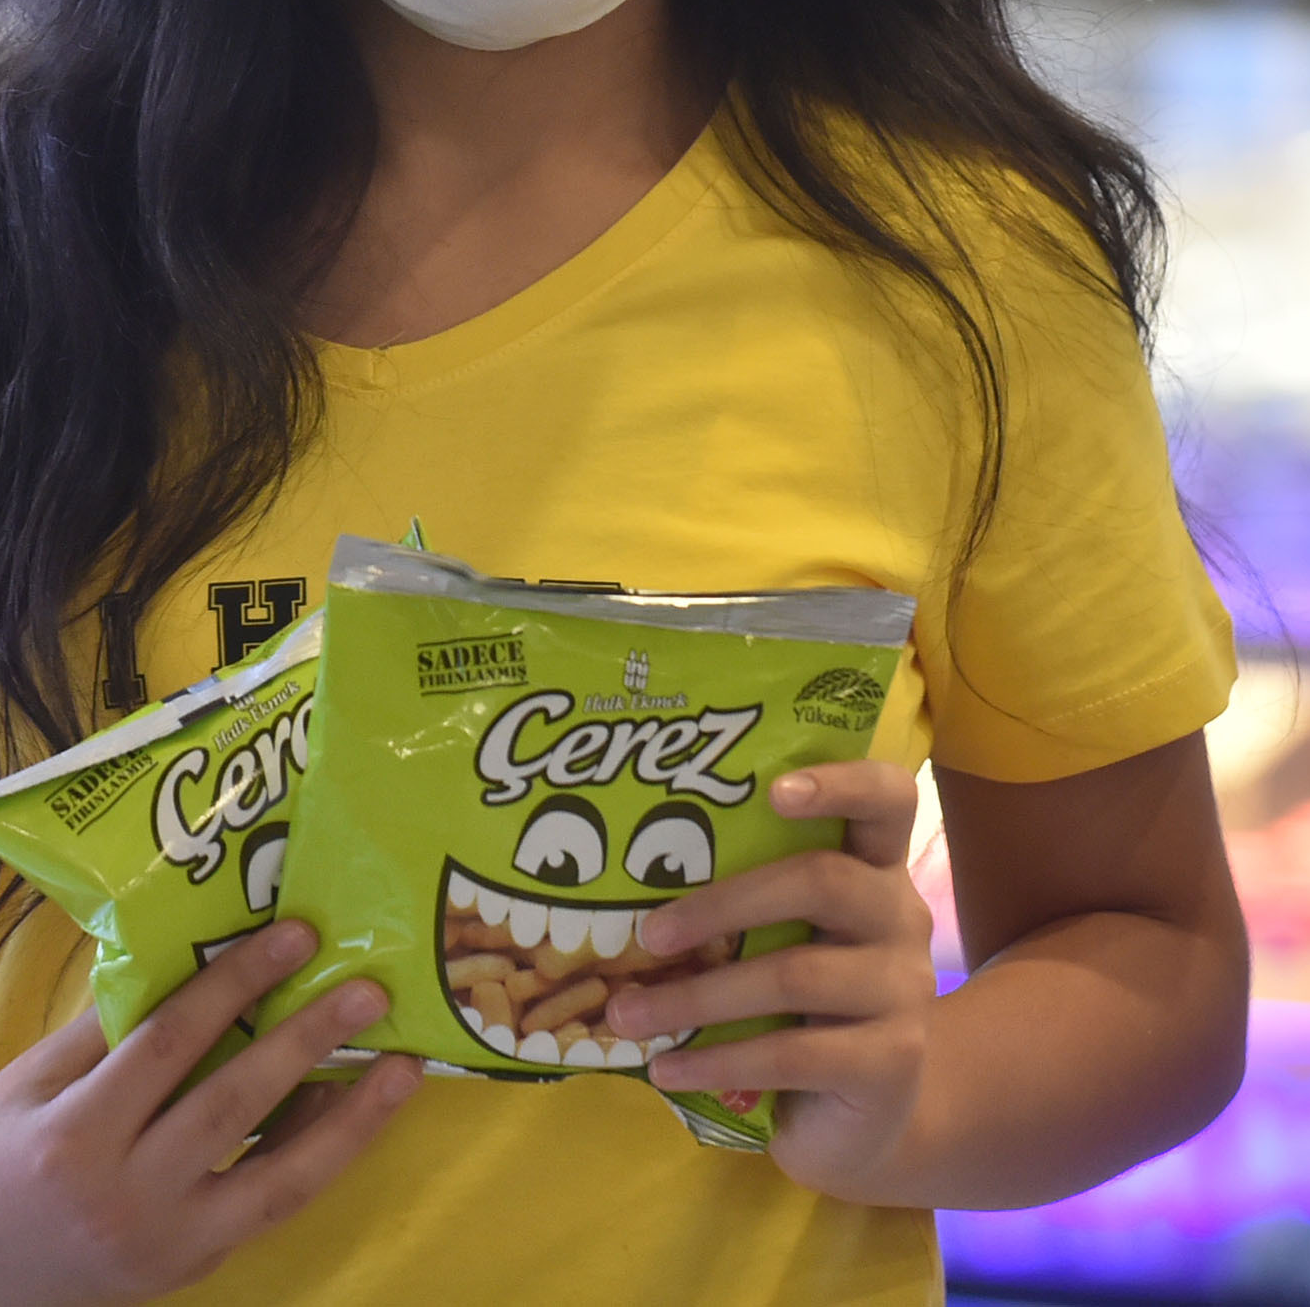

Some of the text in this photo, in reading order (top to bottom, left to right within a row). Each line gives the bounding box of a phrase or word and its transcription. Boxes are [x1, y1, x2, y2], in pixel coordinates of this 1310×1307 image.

[416, 639, 525, 674] SADECE
[213, 679, 301, 753] Halk Ekmek
[583, 692, 689, 714] Halk Ekmek
[793, 705, 850, 731] Yüksek
[474, 688, 764, 807] Çerez
[150, 690, 315, 884] Çer
